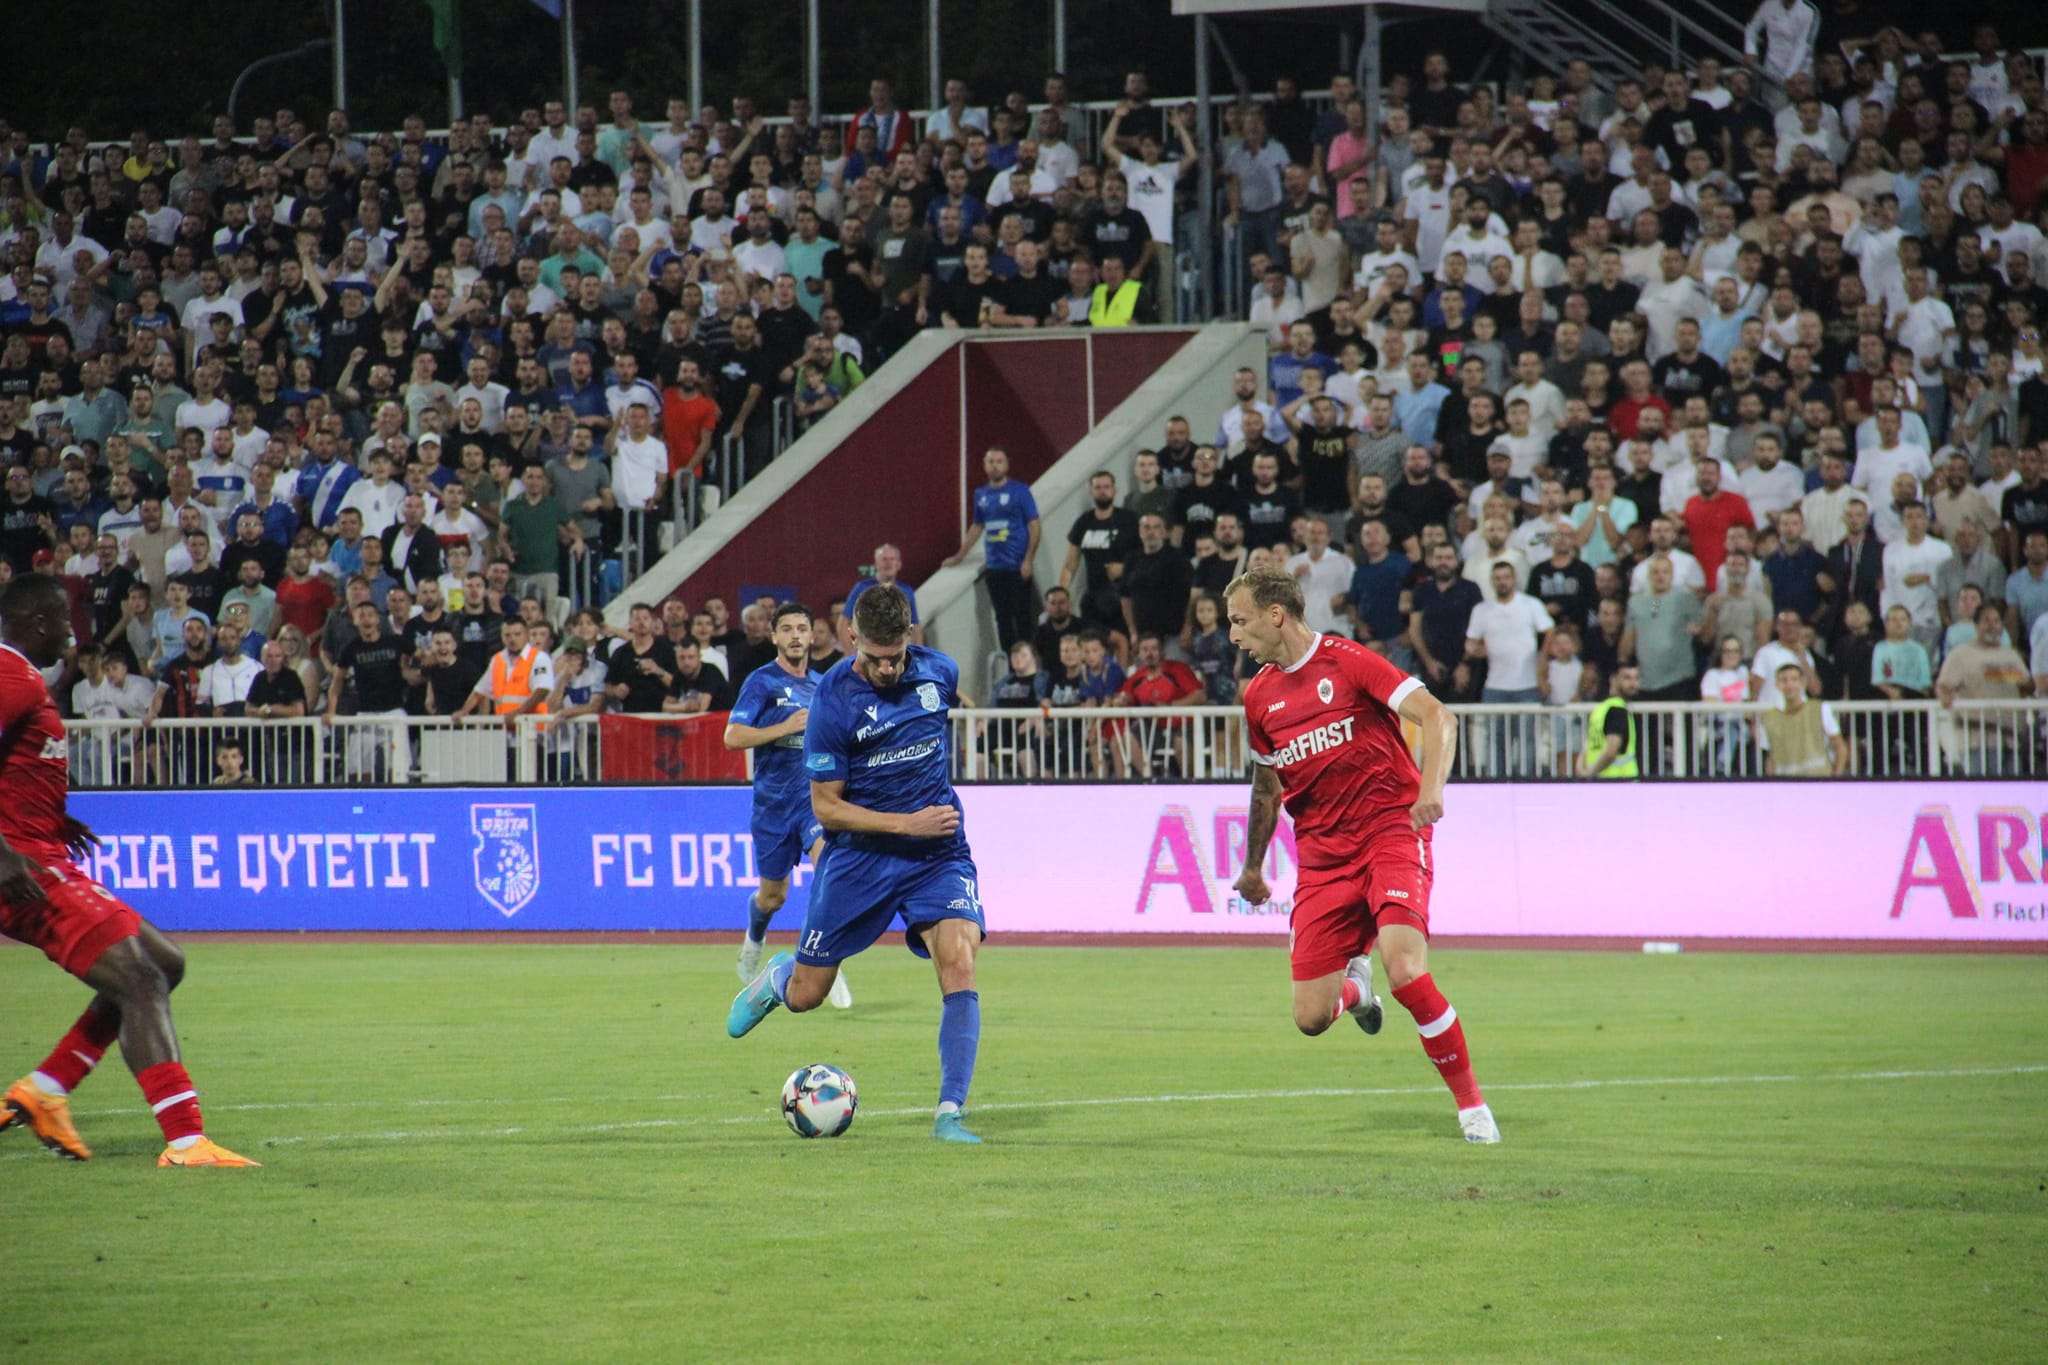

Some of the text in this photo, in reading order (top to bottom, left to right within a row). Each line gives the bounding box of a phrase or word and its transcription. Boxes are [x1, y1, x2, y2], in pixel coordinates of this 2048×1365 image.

[1268, 701, 1286, 713] JAKO
[191, 835, 221, 888] E
[237, 833, 436, 894] QYTETIT
[592, 834, 816, 888] FC DRI
[1386, 889, 1409, 899] JAKO
